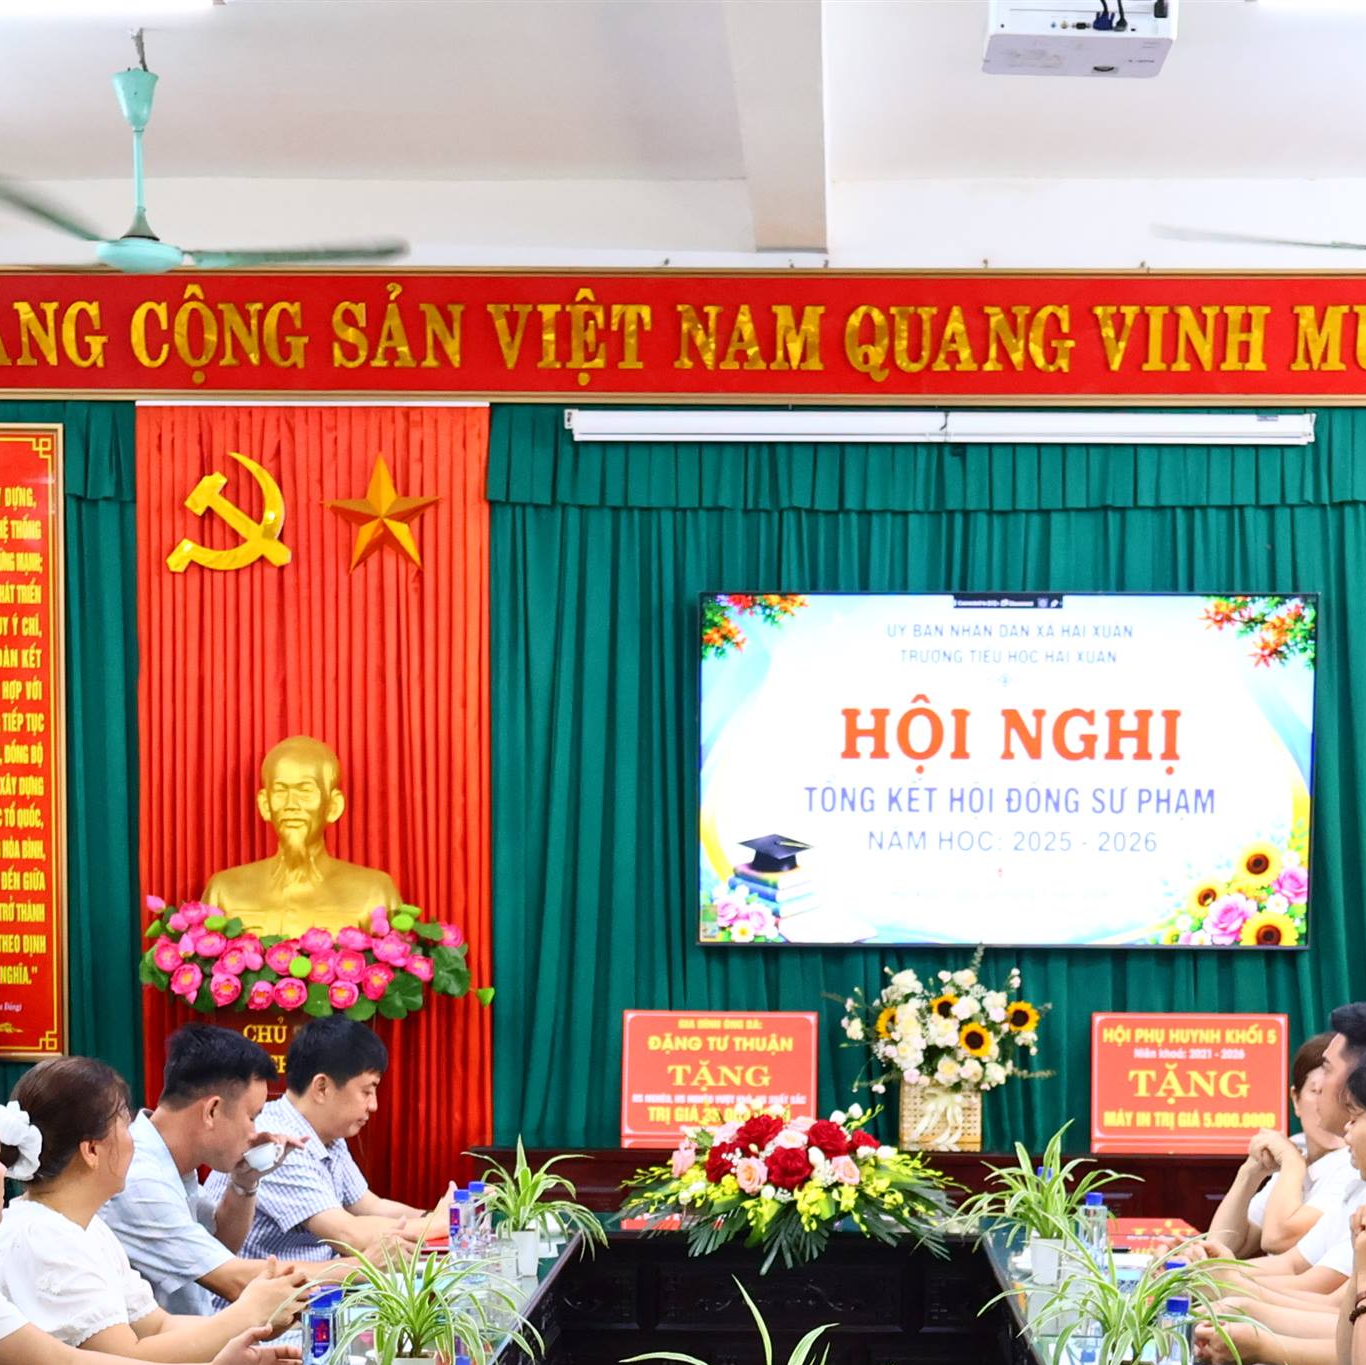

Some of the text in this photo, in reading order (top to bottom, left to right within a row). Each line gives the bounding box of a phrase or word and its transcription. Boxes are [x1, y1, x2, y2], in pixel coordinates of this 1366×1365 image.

[130, 284, 309, 385] CỘNG
[332, 283, 464, 369] SẢN
[486, 288, 651, 386] VIỆT
[676, 304, 826, 371] NAM
[845, 304, 1074, 382] QUANG
[1092, 305, 1271, 372] VINH
[22, 642, 42, 668] KẾT
[2, 680, 22, 704] HỢP
[26, 675, 42, 700] VỚI
[841, 693, 1181, 775] HỘI NGHỊ
[1092, 786, 1128, 814] SƯ
[1012, 831, 1072, 852] 2025
[1099, 832, 1158, 853] 2026
[23, 934, 46, 957] ĐỊNH
[243, 1017, 287, 1043] CHỦ
[1103, 1024, 1276, 1047] HỘI PHỤ HUYNH KHỐI 5
[648, 1033, 793, 1055] ĐẶNG TƯ THUẬN
[668, 1060, 771, 1091] TẶNG
[1129, 1063, 1250, 1104] TẶNG
[648, 1106, 670, 1124] TRỊ
[674, 1106, 697, 1122] GIÁ
